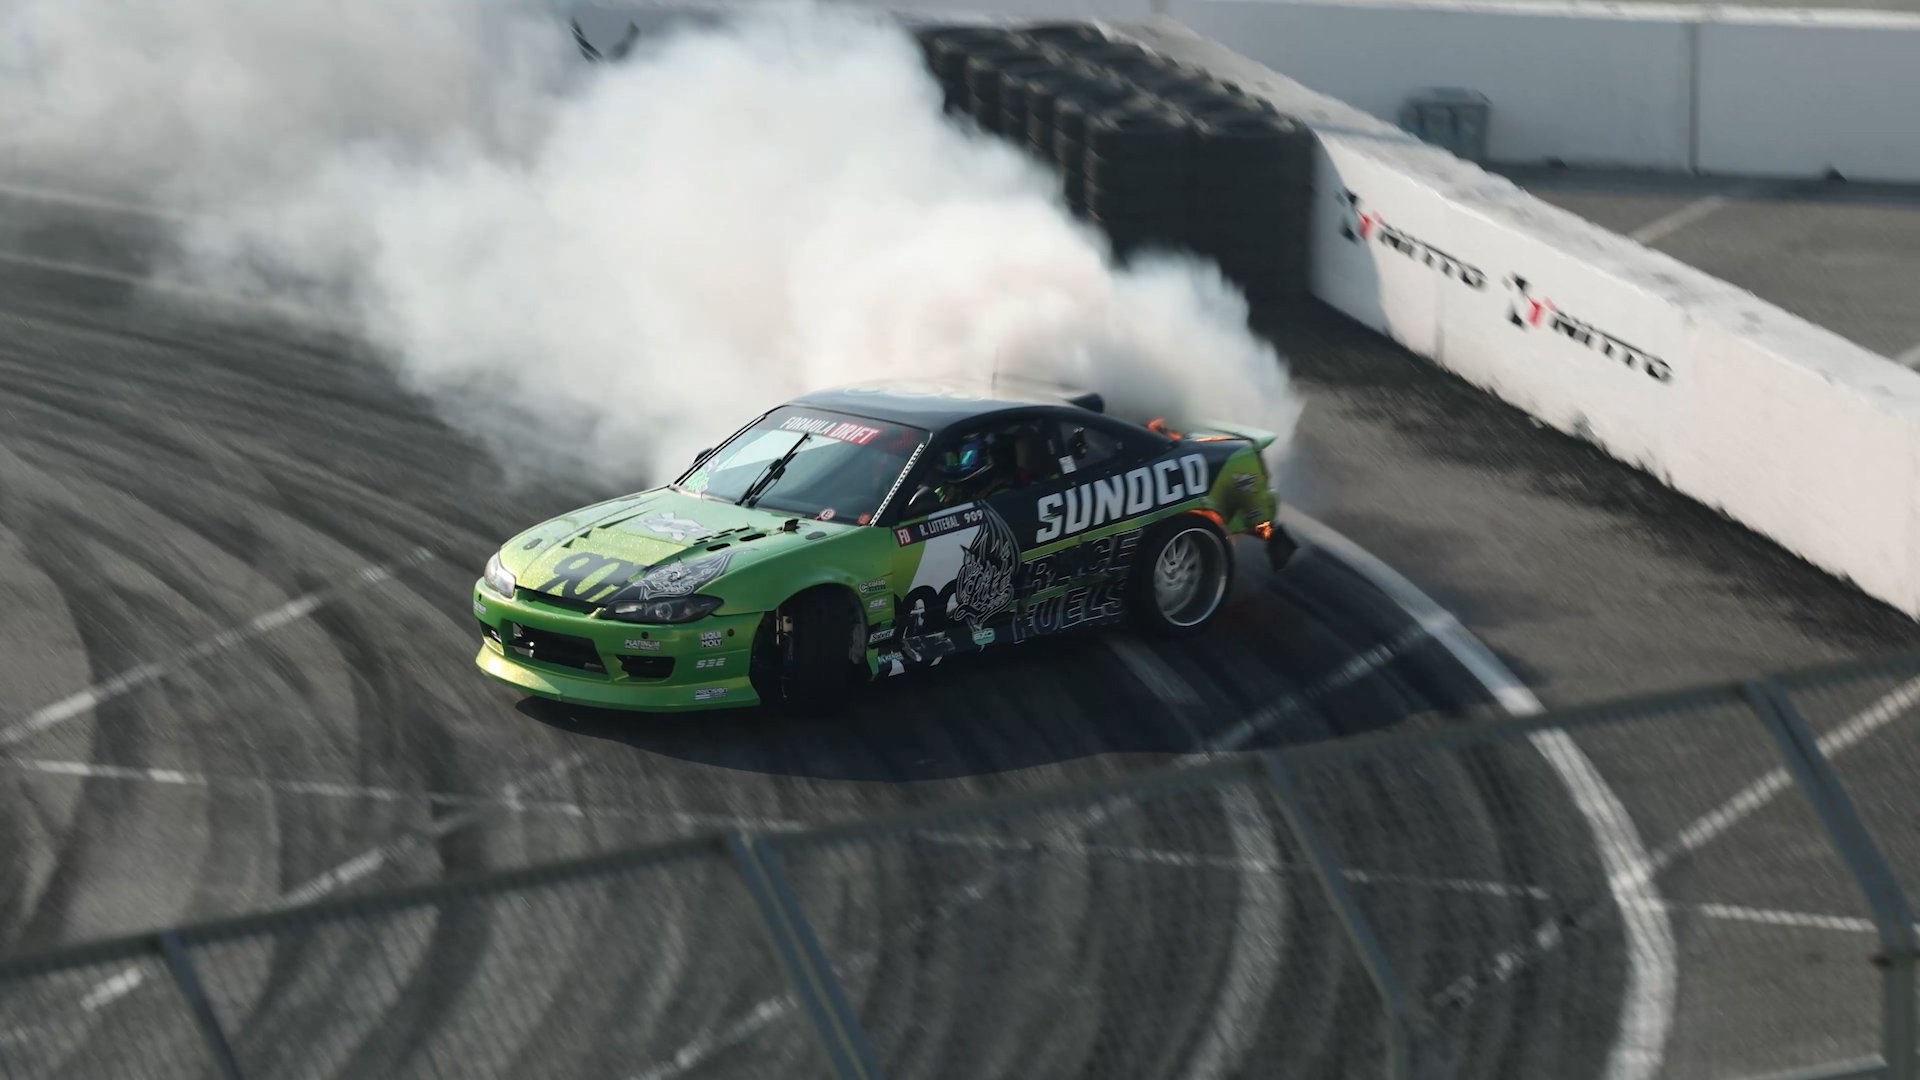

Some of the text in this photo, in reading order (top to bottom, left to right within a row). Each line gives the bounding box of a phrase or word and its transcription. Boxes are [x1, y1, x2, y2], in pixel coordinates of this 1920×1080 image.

[1549, 308, 1674, 384] NITTO
[779, 416, 880, 445] FORMULA DRIFT
[1036, 453, 1209, 543] SUNOCO
[897, 528, 911, 545] FD
[928, 515, 960, 534] LITTERAL
[964, 509, 983, 524] 909
[701, 631, 722, 640] LIQUI
[701, 639, 722, 647] MOLY
